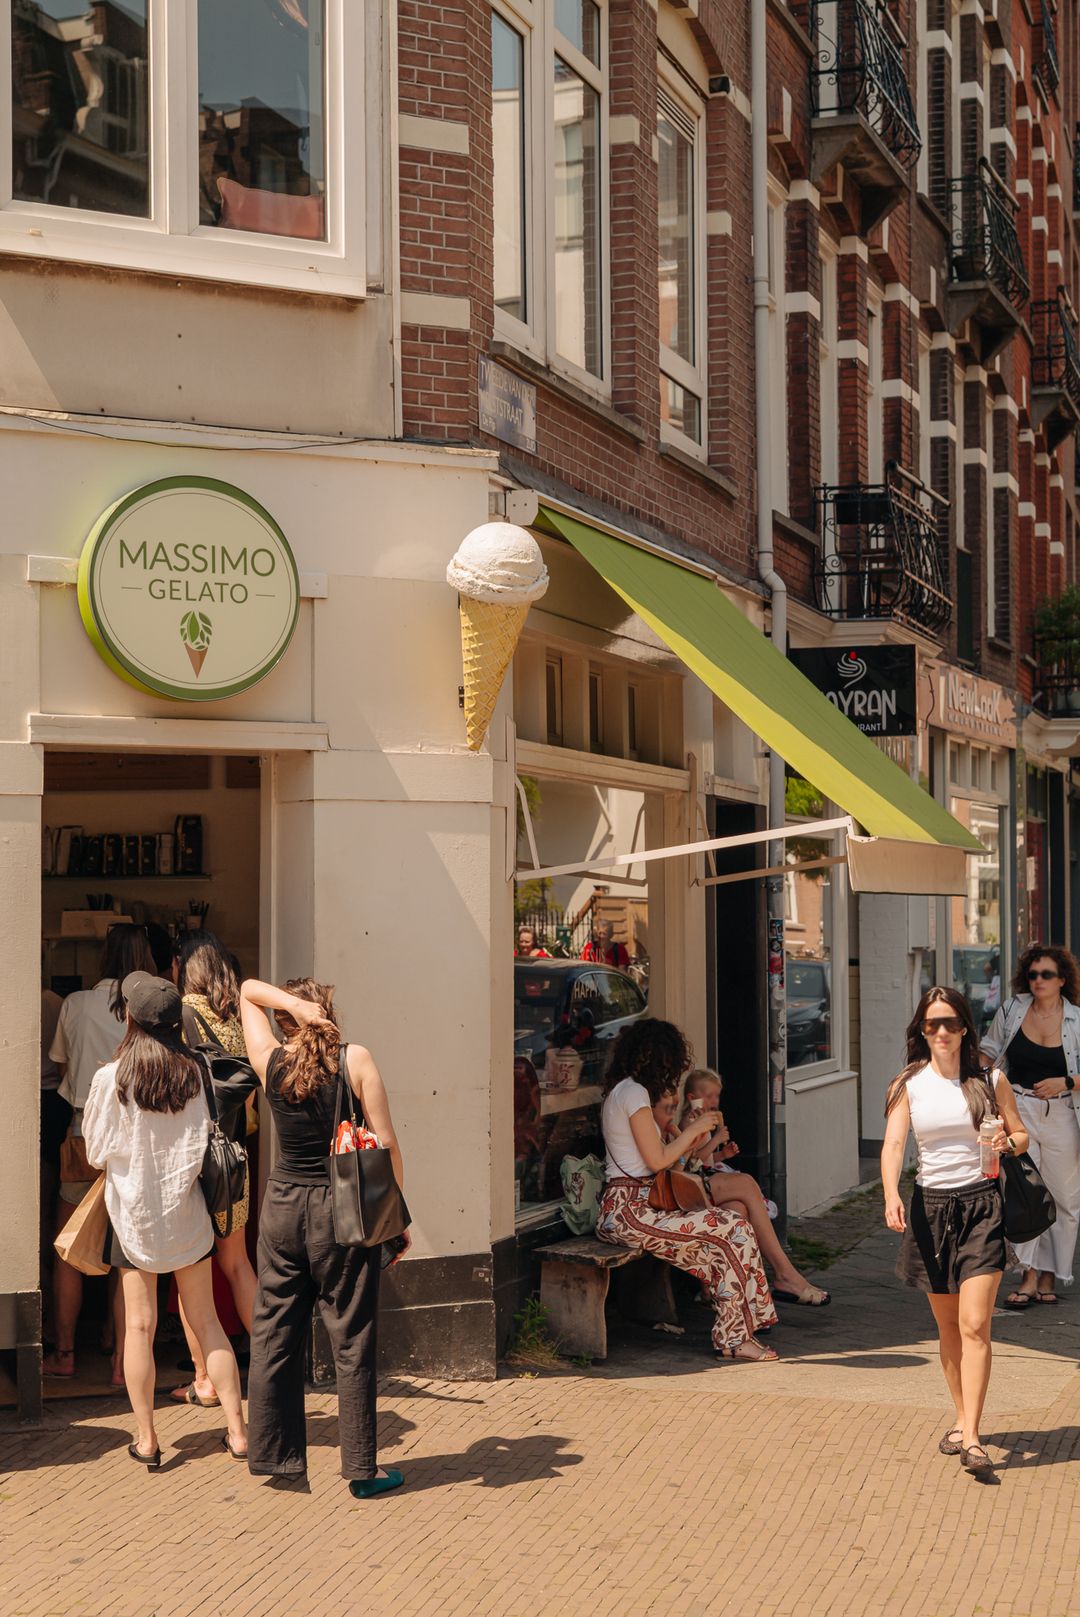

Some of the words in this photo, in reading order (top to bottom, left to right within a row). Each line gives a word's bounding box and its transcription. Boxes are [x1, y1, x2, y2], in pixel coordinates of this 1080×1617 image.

[119, 539, 276, 577] MASSIMO
[148, 578, 249, 604] GELATO
[857, 722, 882, 731] RANT
